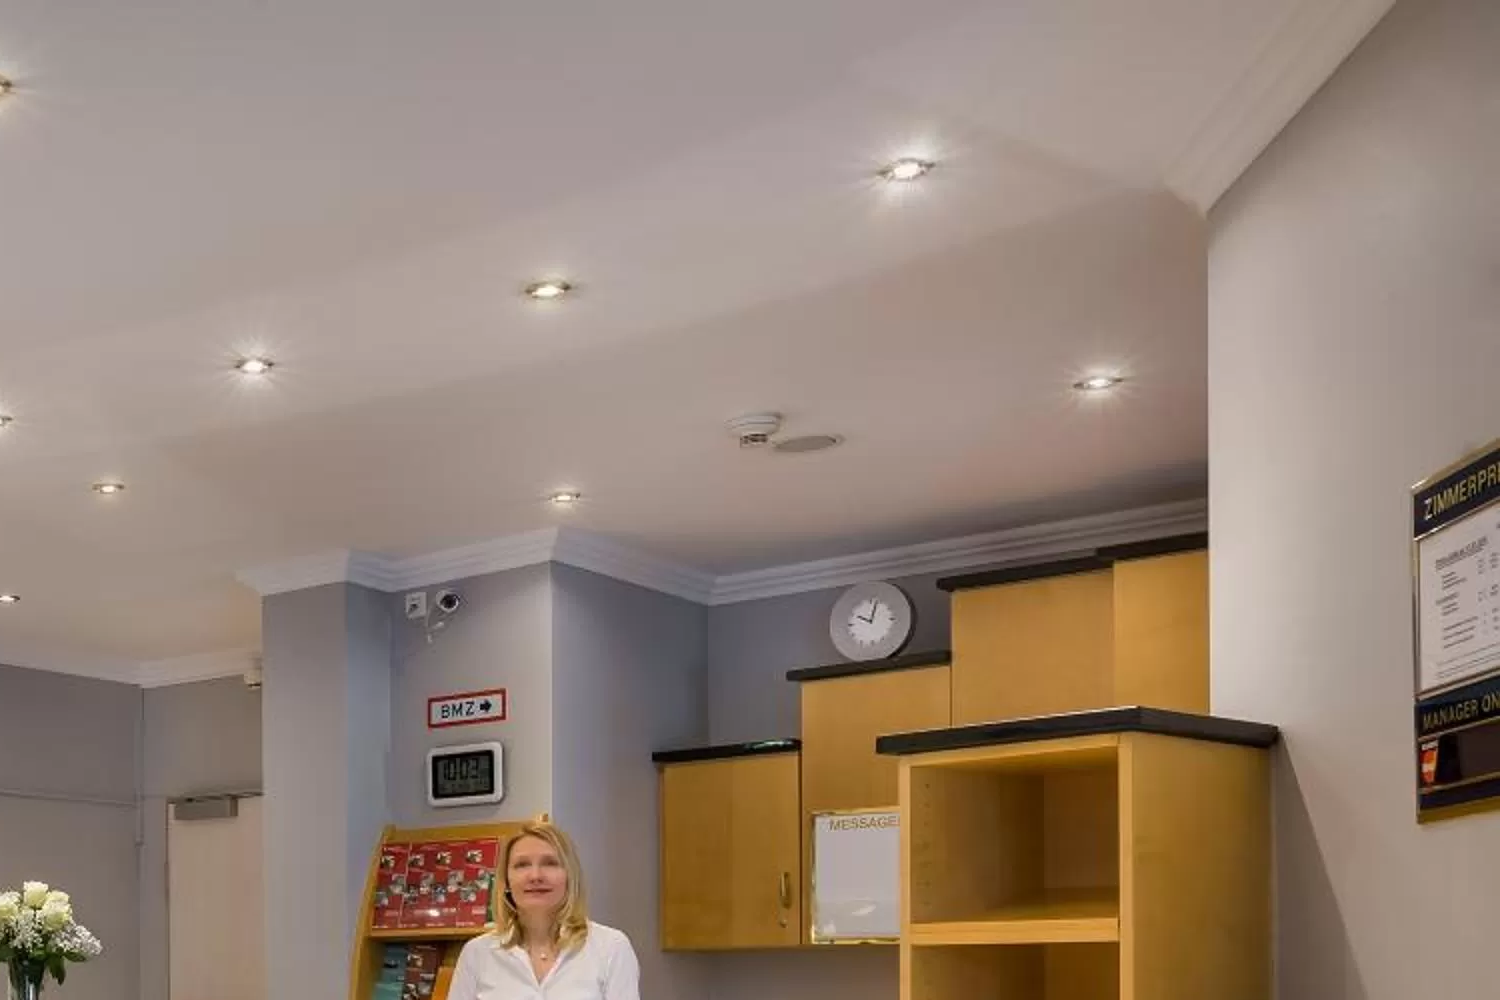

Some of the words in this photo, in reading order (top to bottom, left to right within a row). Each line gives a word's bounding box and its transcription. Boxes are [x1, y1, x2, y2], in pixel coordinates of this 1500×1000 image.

[441, 701, 475, 719] BMZ
[1423, 699, 1479, 730] MANAGER
[829, 815, 900, 831] MESSAGE
